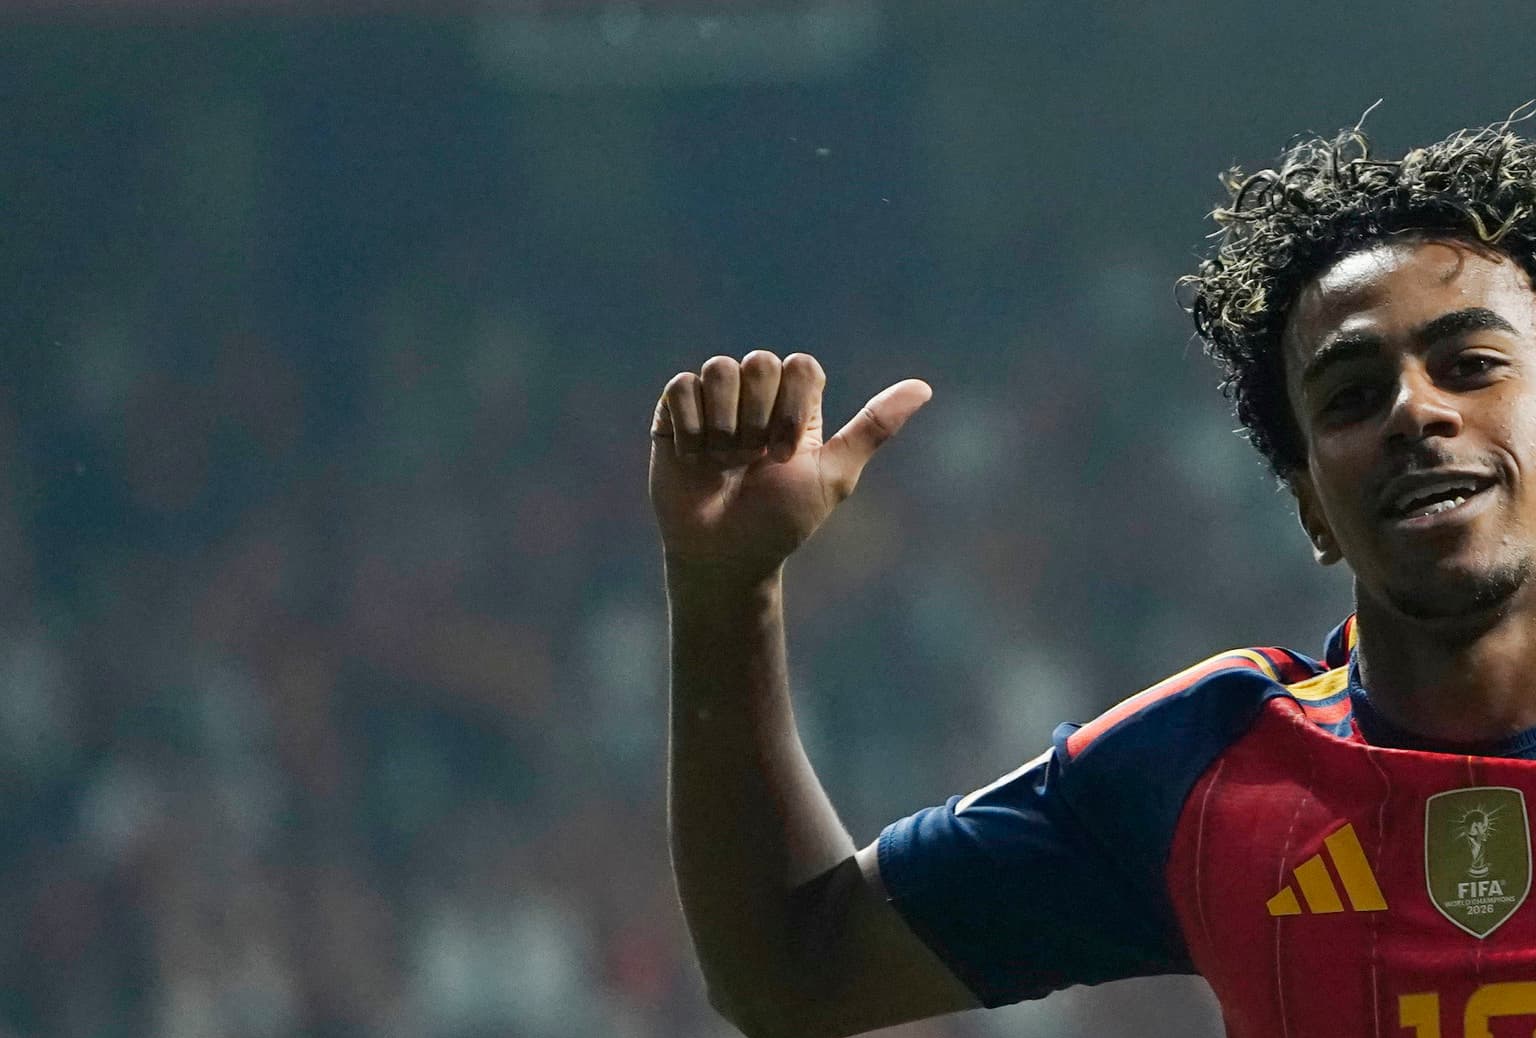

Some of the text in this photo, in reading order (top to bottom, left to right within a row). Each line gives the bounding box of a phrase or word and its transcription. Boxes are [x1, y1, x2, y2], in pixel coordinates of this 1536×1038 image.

[1457, 880, 1504, 899] FIFA
[1444, 896, 1516, 908] WORLD CHAMPIONS
[1466, 905, 1494, 915] 2026
